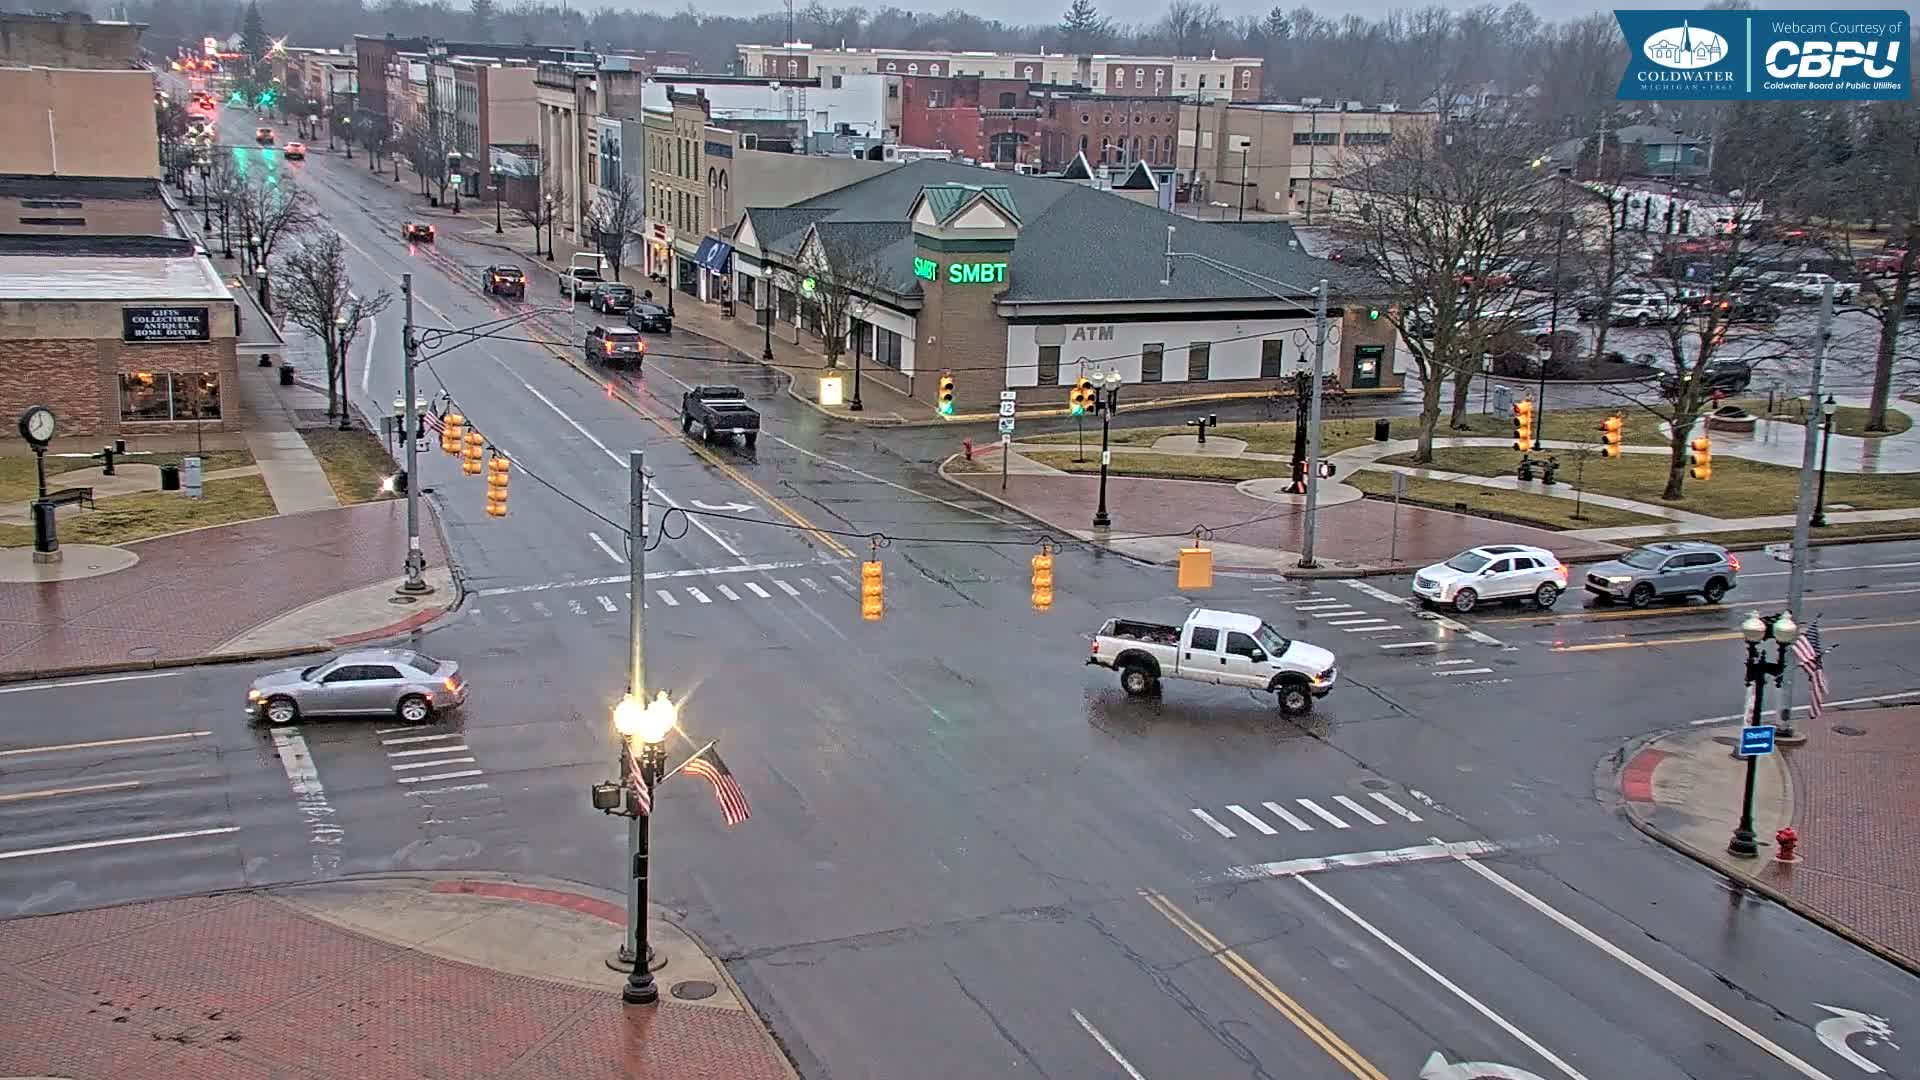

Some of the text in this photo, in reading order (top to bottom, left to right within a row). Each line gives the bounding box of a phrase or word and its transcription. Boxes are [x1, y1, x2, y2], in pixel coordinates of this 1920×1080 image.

[914, 257, 936, 281] SMBT
[949, 263, 1007, 283] SMBT
[1072, 326, 1114, 341] ATM
[1003, 403, 1013, 413] 12
